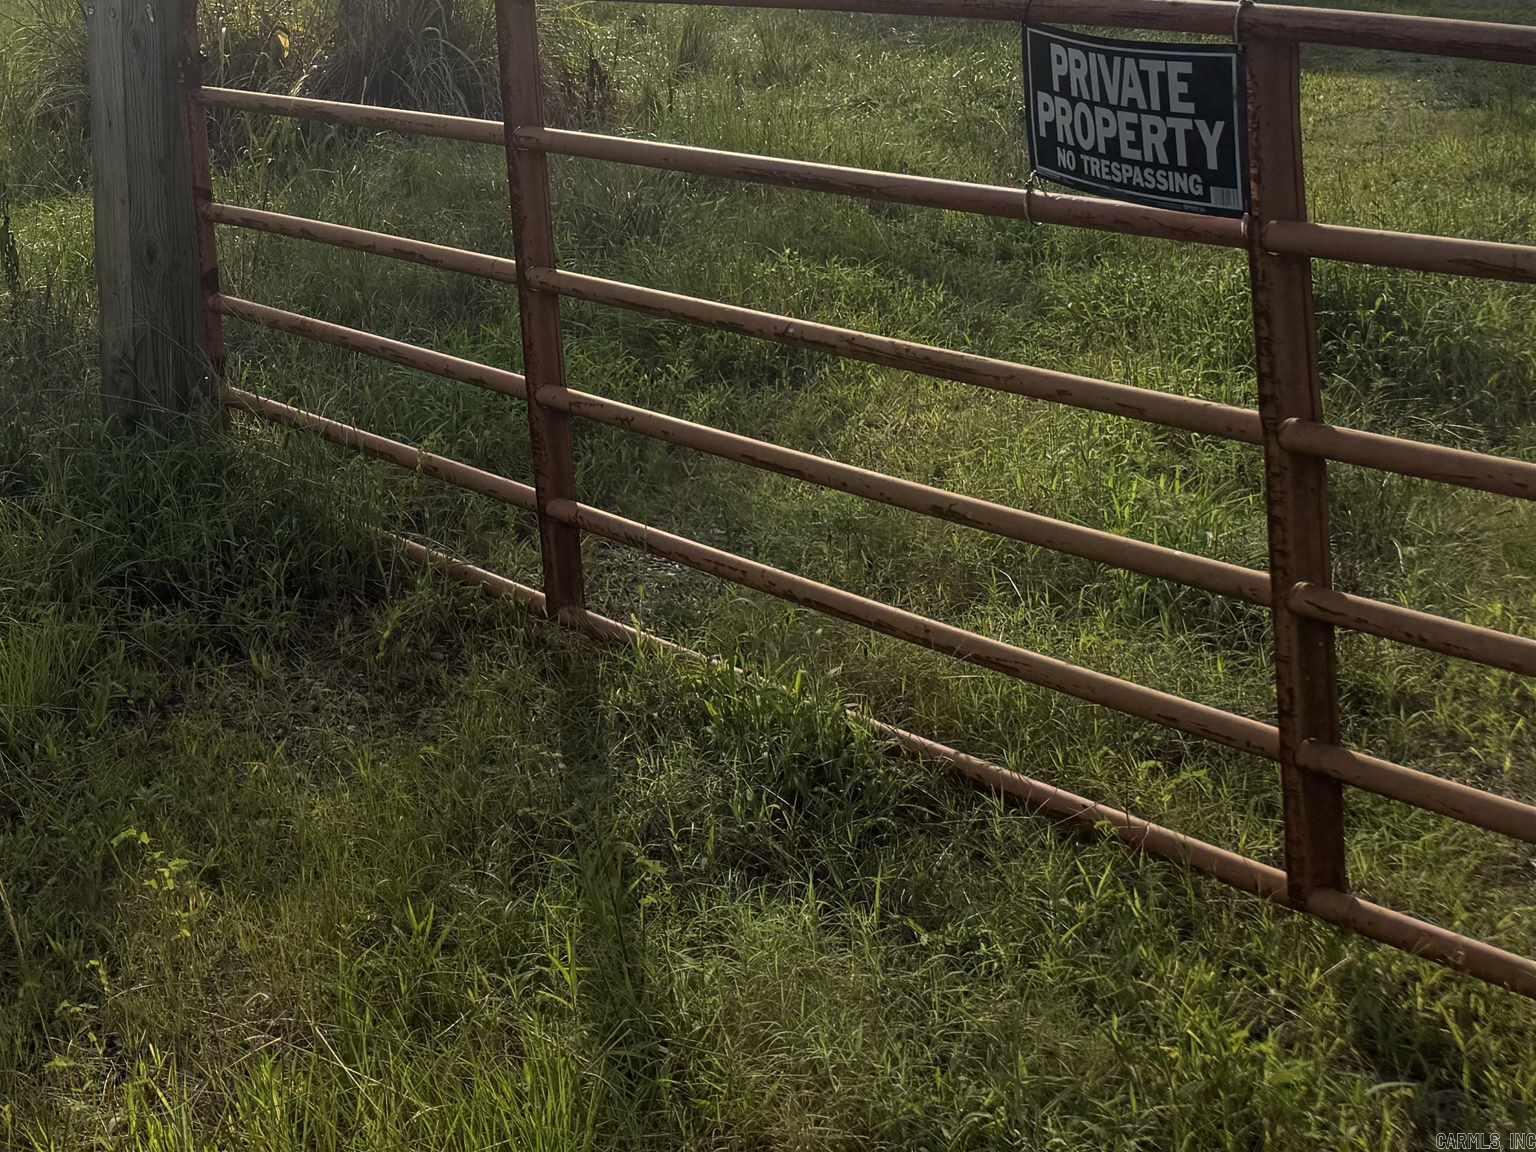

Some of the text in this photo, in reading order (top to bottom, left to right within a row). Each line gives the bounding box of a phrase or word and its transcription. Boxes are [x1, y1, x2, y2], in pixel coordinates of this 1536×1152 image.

[1049, 42, 1196, 115] PRIVATE
[1036, 90, 1225, 171] PROPERTY
[1056, 146, 1204, 197] NO TRESPASSING
